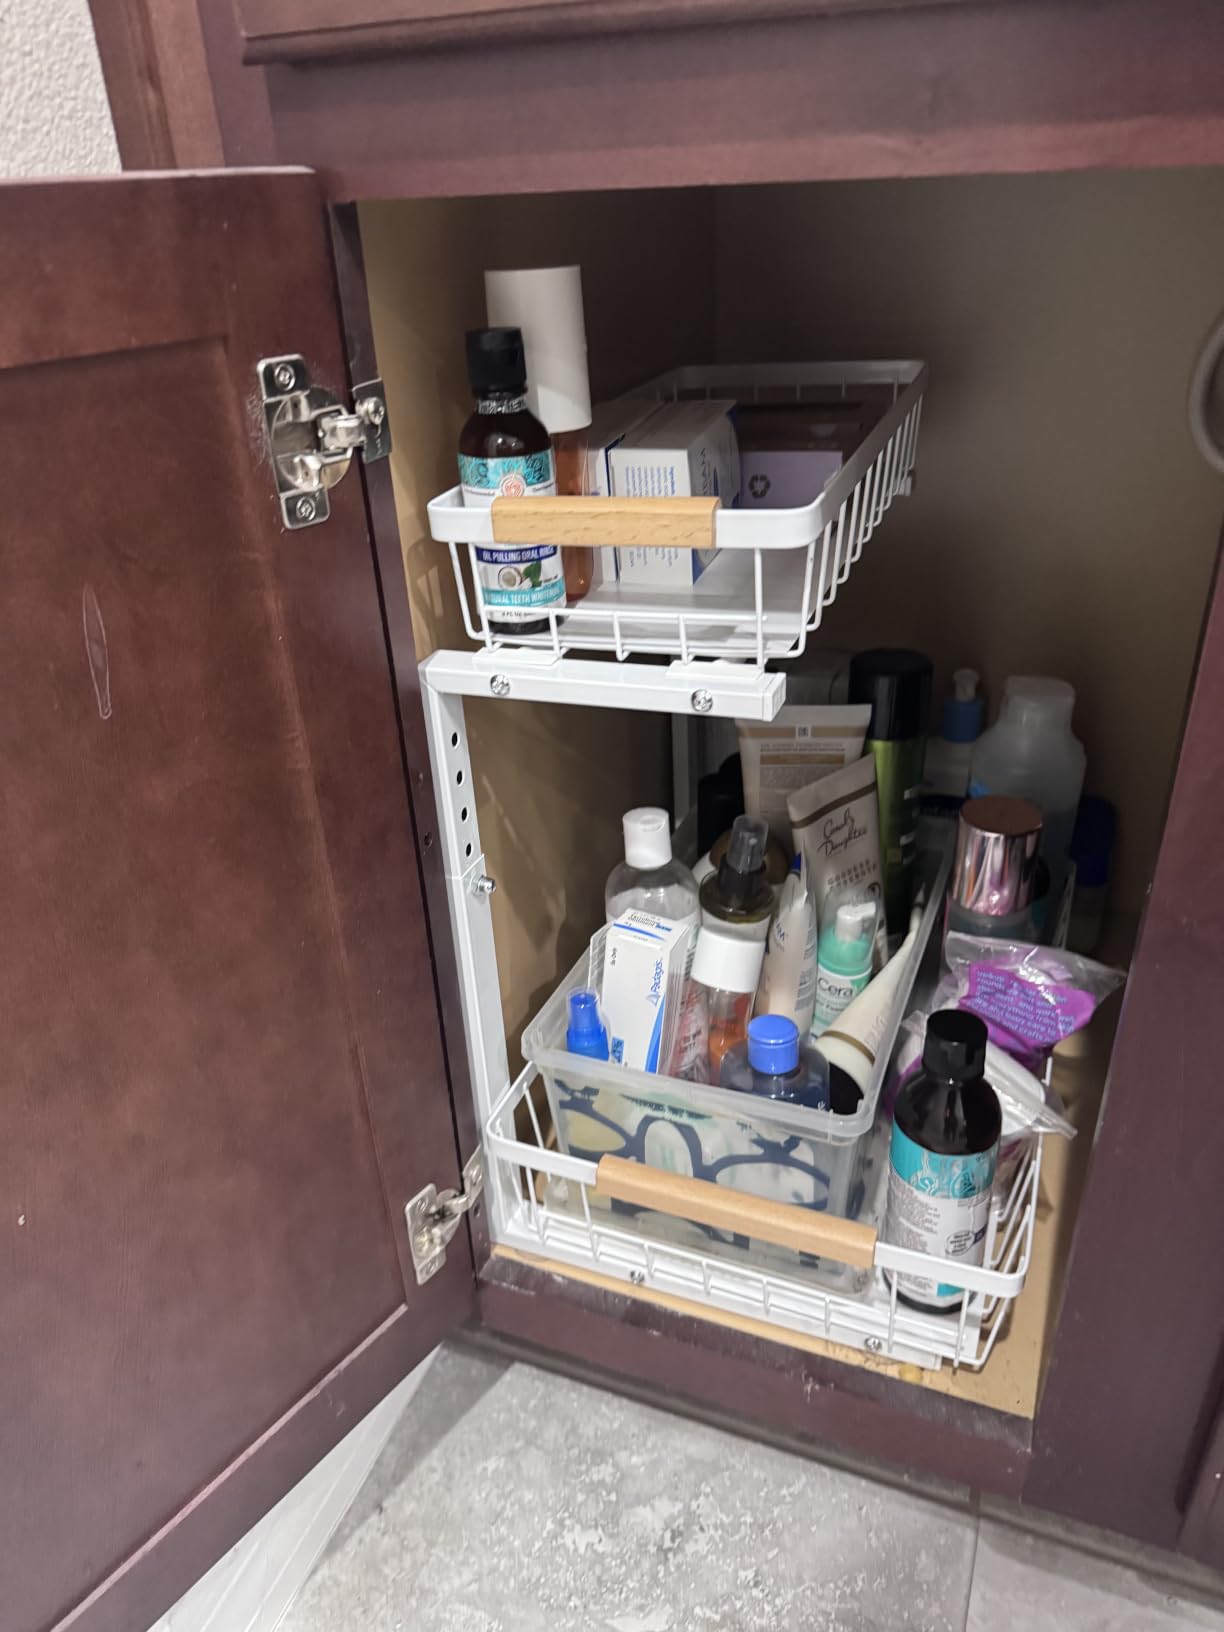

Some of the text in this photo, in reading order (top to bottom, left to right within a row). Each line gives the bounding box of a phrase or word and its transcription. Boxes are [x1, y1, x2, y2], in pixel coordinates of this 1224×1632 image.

[492, 550, 521, 561] PULLING
[521, 549, 539, 560] ORAL
[817, 977, 854, 998] Cera
